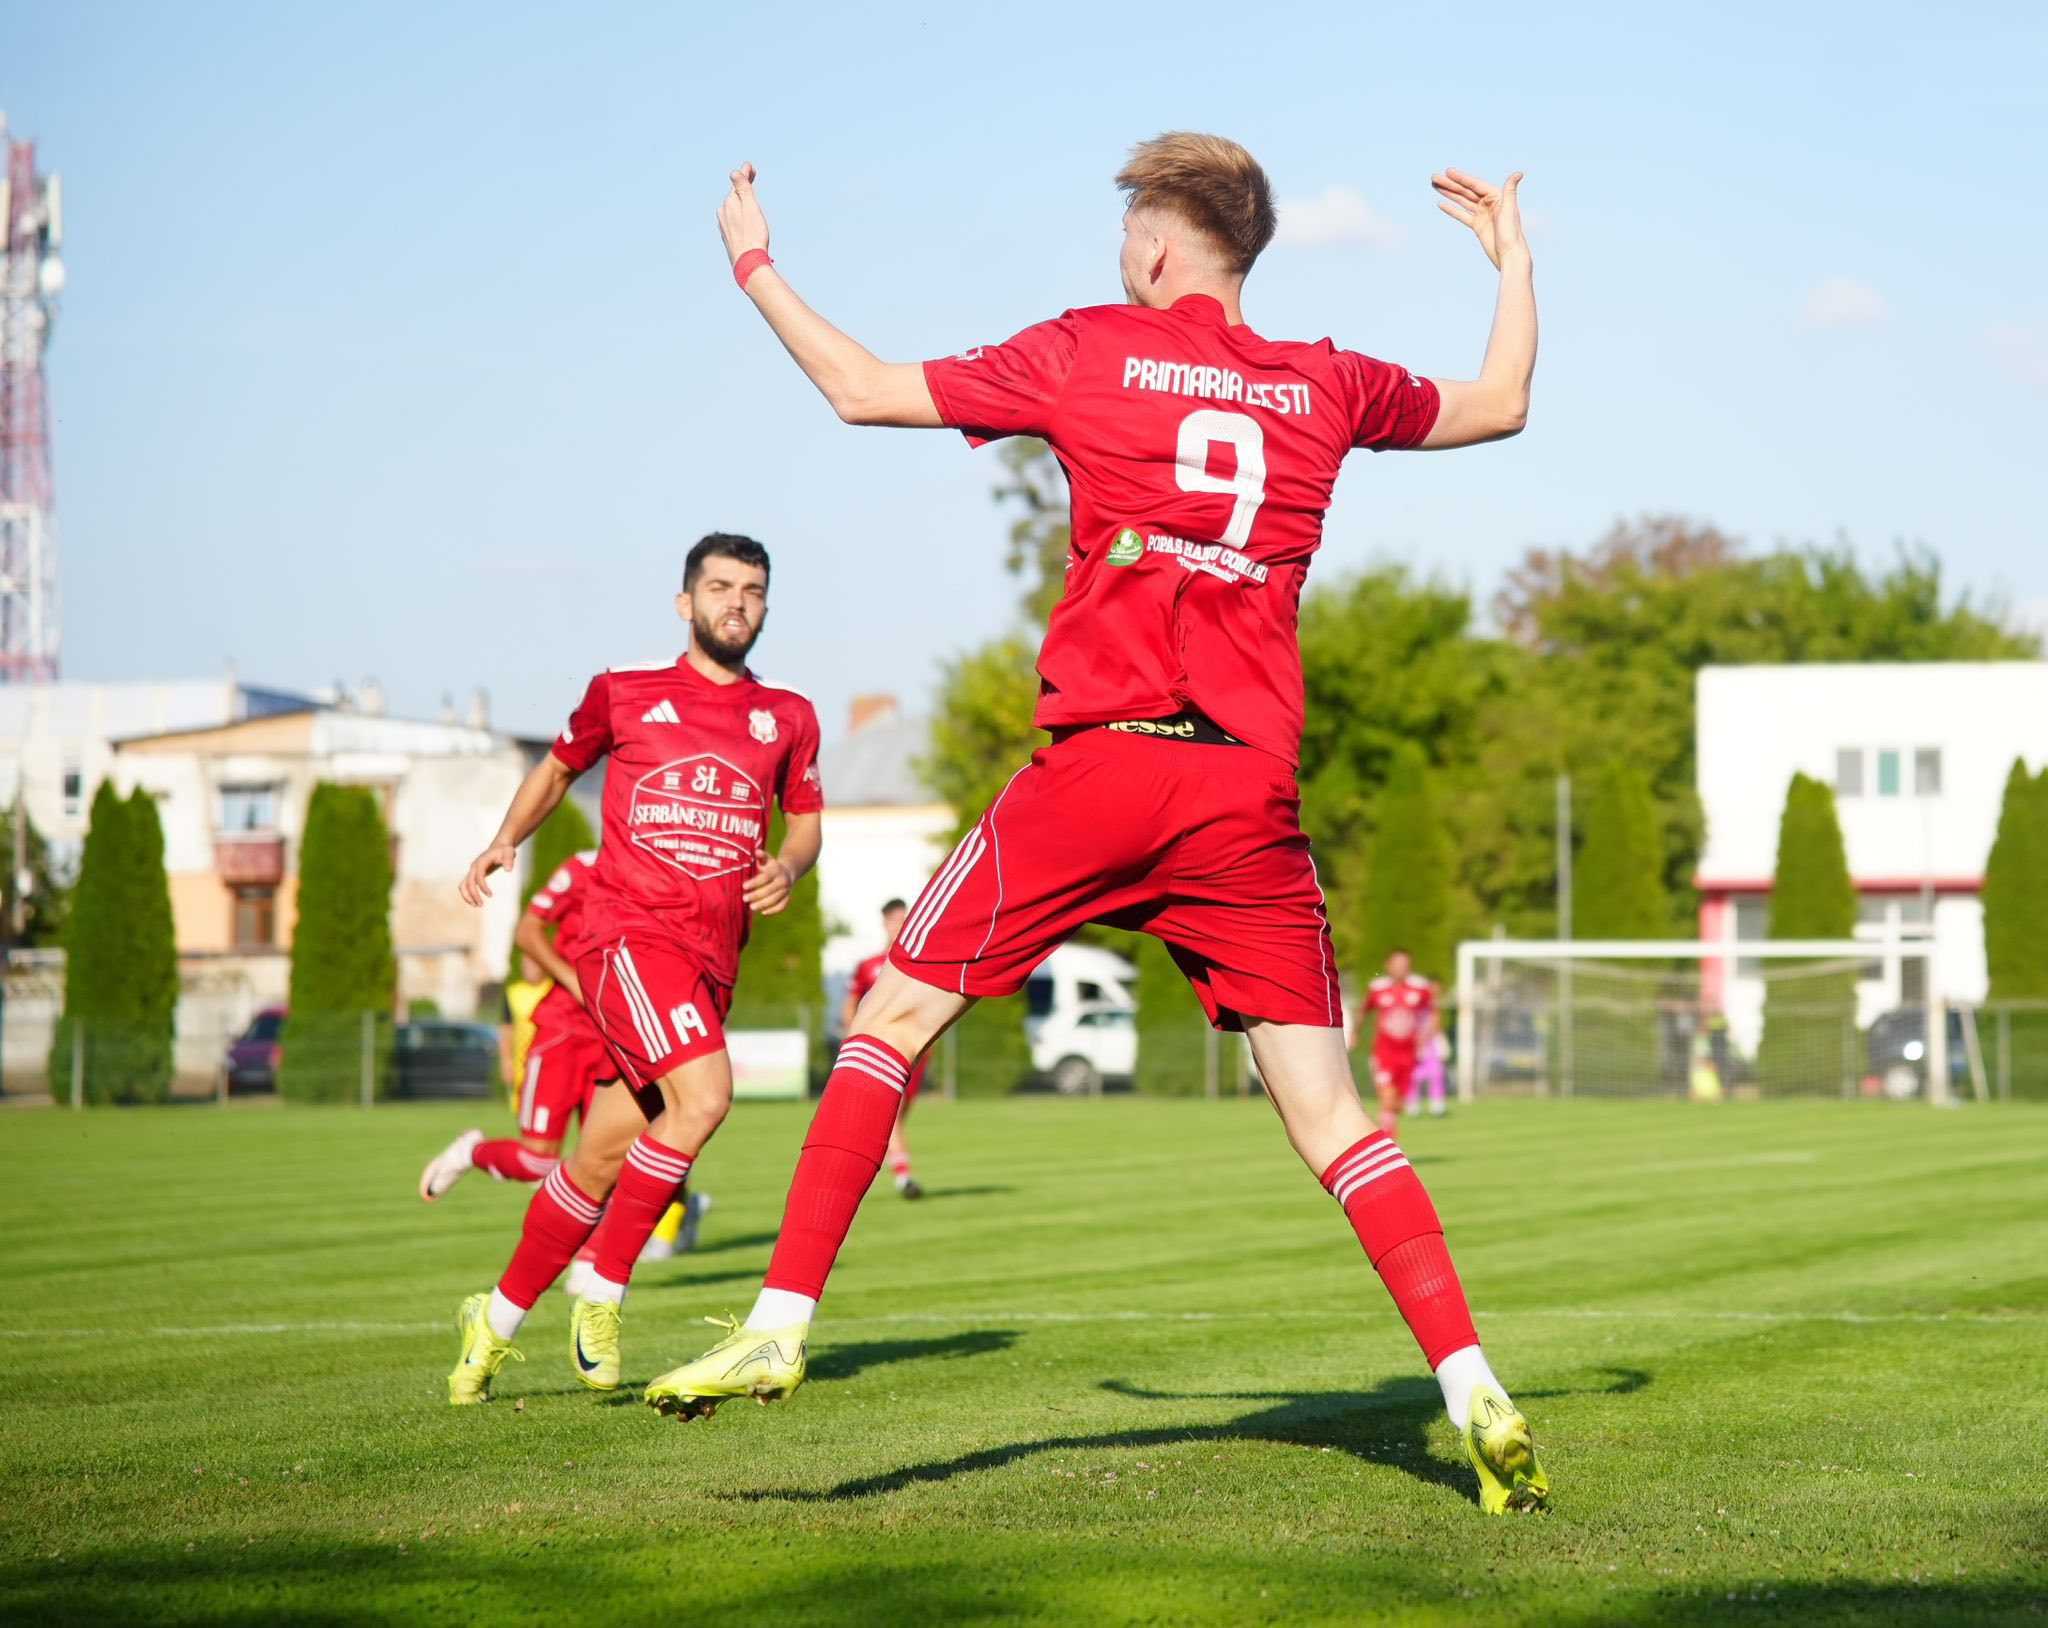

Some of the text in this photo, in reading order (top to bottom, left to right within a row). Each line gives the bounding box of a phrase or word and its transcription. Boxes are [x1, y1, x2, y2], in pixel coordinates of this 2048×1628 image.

[1123, 357, 1243, 402] PRIMARIA
[1175, 409, 1267, 550] 9
[1146, 534, 1183, 555] POPAS
[1183, 540, 1223, 562] HANU
[1101, 720, 1195, 738] esse
[669, 1002, 708, 1045] 19
